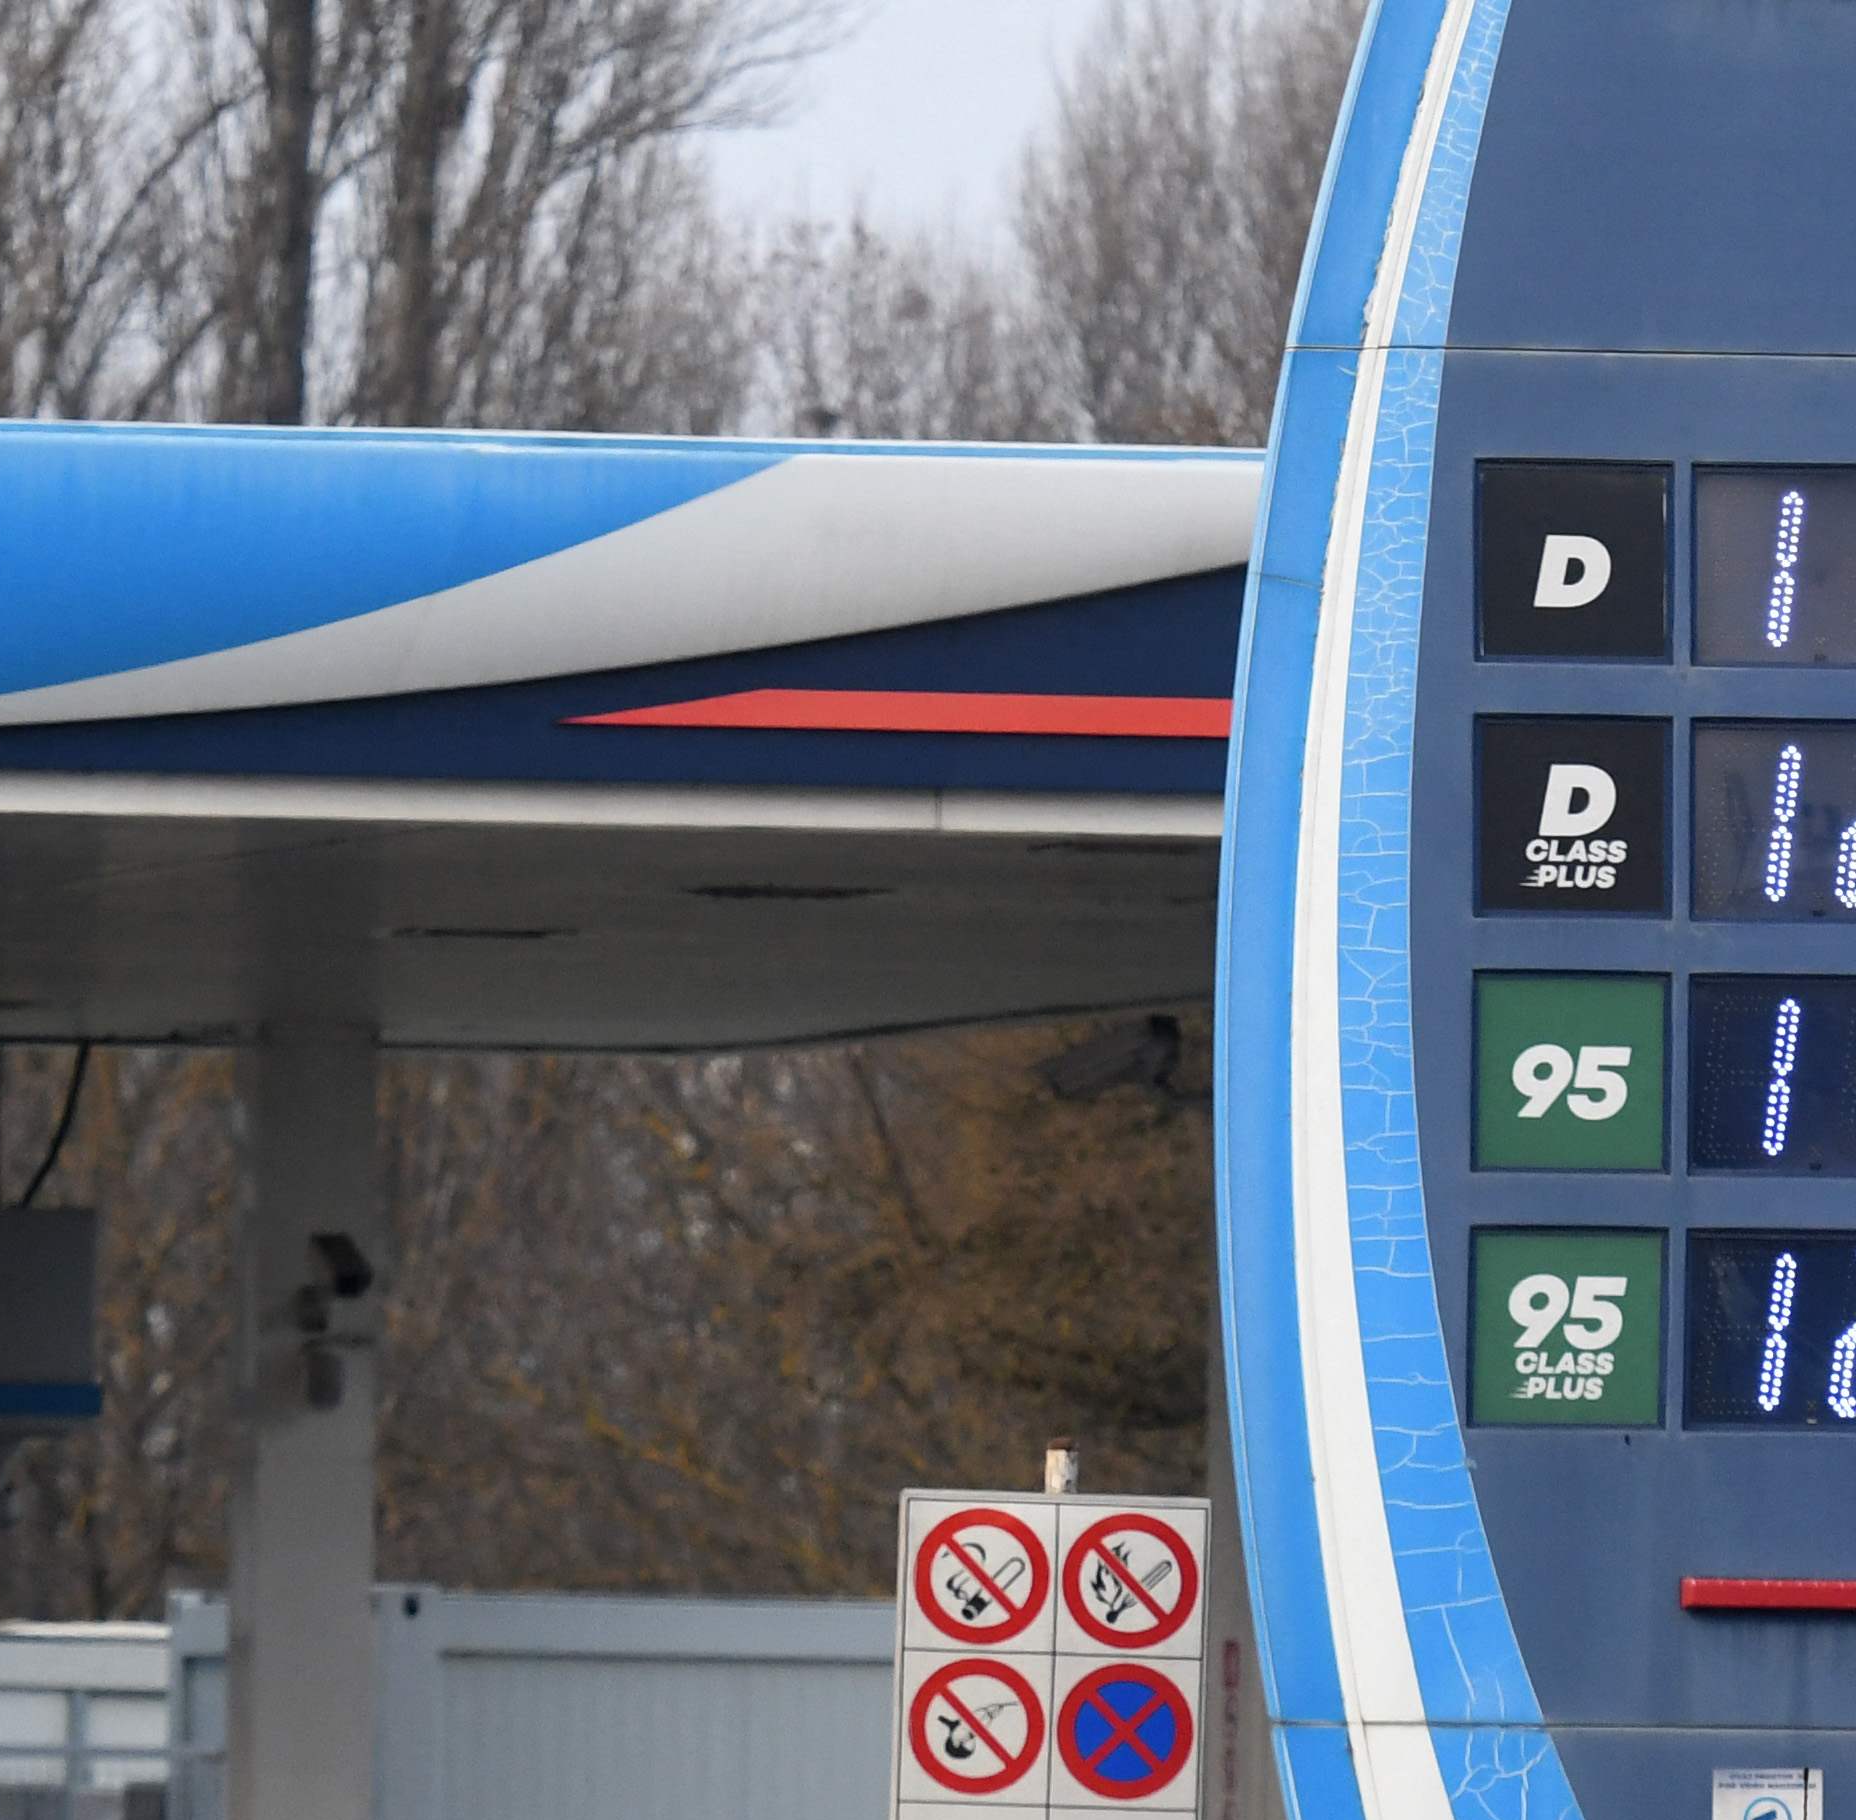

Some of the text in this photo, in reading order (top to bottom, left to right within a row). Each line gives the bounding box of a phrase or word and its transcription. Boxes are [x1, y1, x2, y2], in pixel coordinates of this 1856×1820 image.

[1533, 534, 1611, 608] D
[1540, 763, 1618, 837] D
[1525, 839, 1628, 865] CLASS
[1536, 865, 1617, 890] PLUS
[1510, 1044, 1632, 1121] 95
[1507, 1273, 1629, 1352] 95
[1514, 1352, 1614, 1376] CLASS
[1524, 1376, 1604, 1401] PLUS
